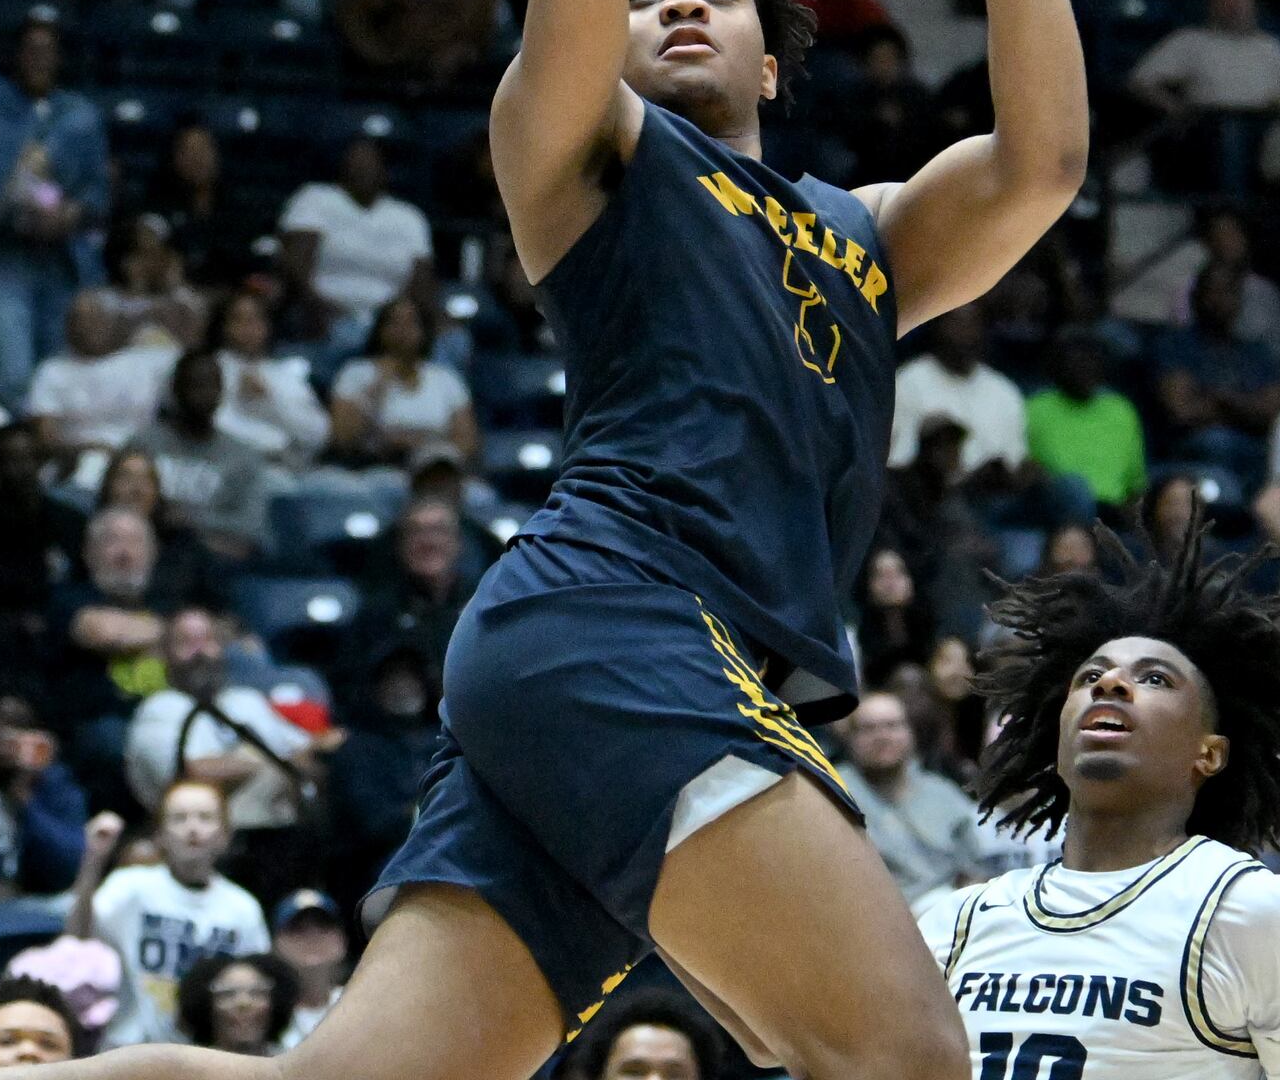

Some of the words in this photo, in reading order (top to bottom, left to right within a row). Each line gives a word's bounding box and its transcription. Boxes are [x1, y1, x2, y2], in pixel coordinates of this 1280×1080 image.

[696, 171, 889, 316] WEELER
[955, 972, 1164, 1028] FALCONS
[979, 1032, 1088, 1080] 10
